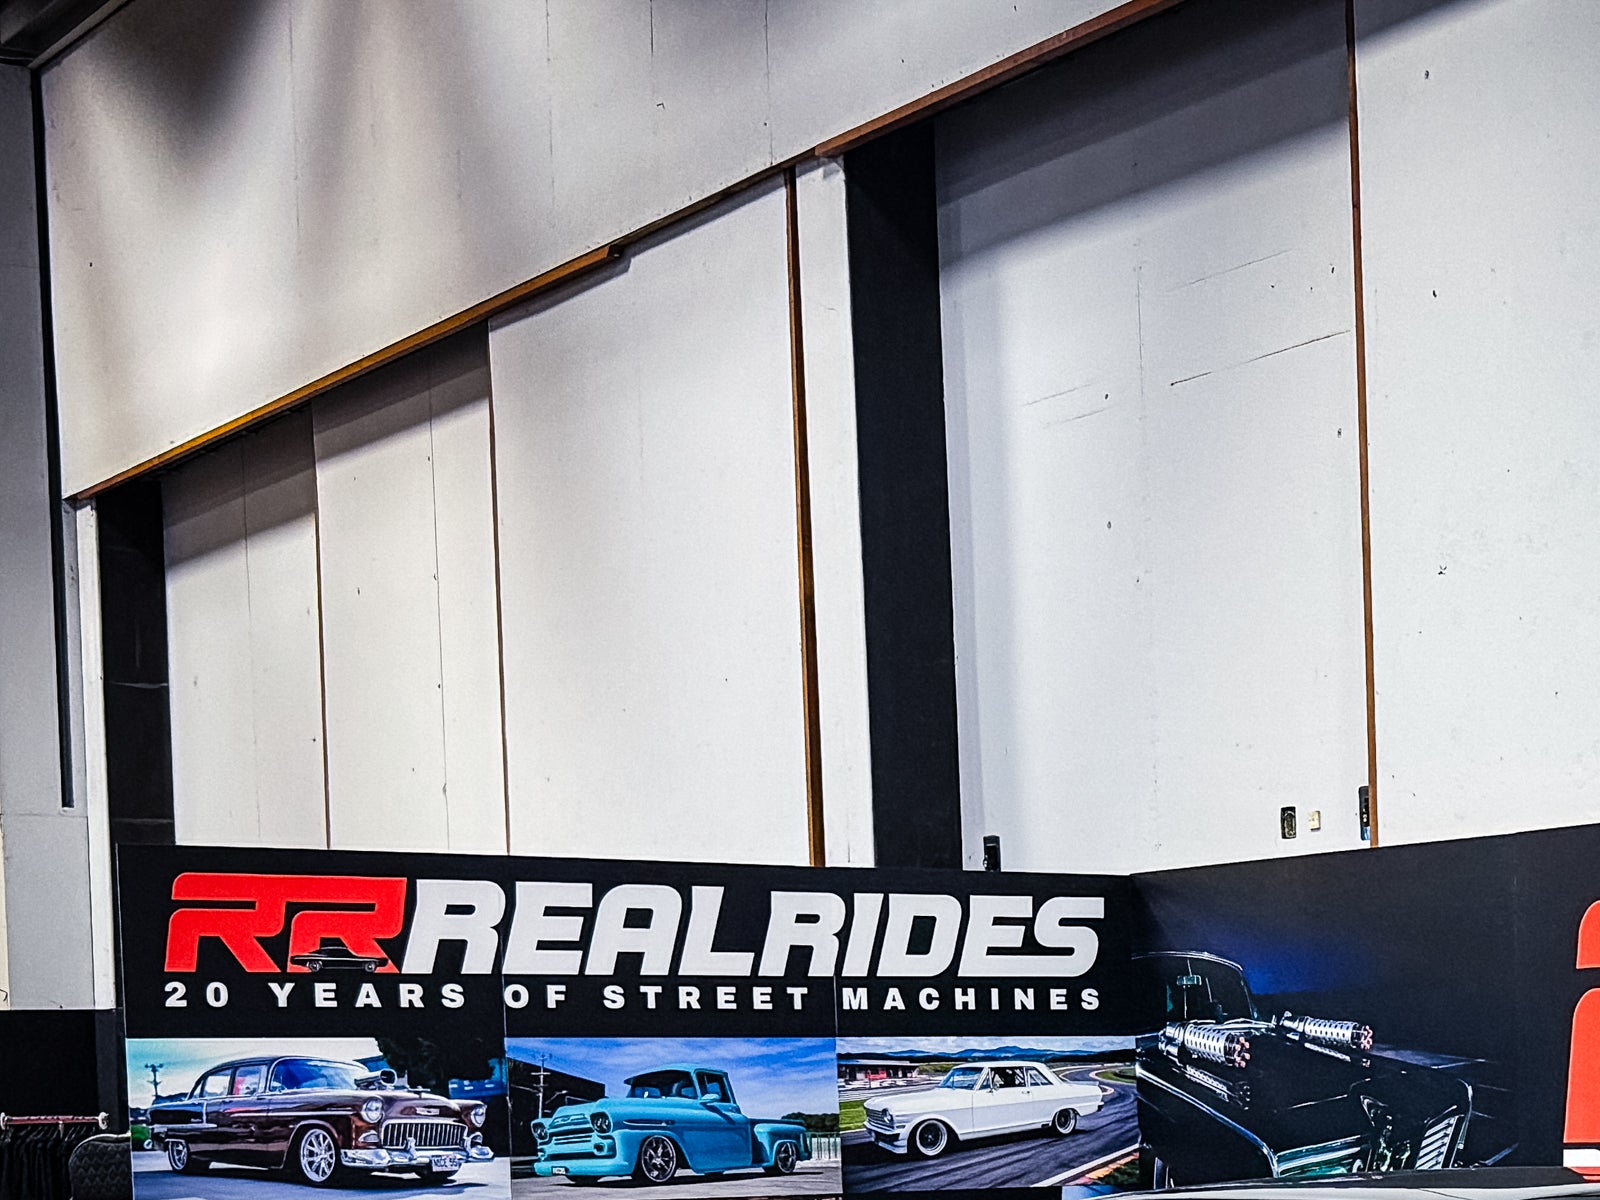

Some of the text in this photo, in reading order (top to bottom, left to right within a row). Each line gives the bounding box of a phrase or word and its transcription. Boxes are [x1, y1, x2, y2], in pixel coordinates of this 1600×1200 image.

[403, 879, 1105, 978] REALRIDES
[165, 981, 1100, 1011] 20 YEARS OF STREET MACHINES
